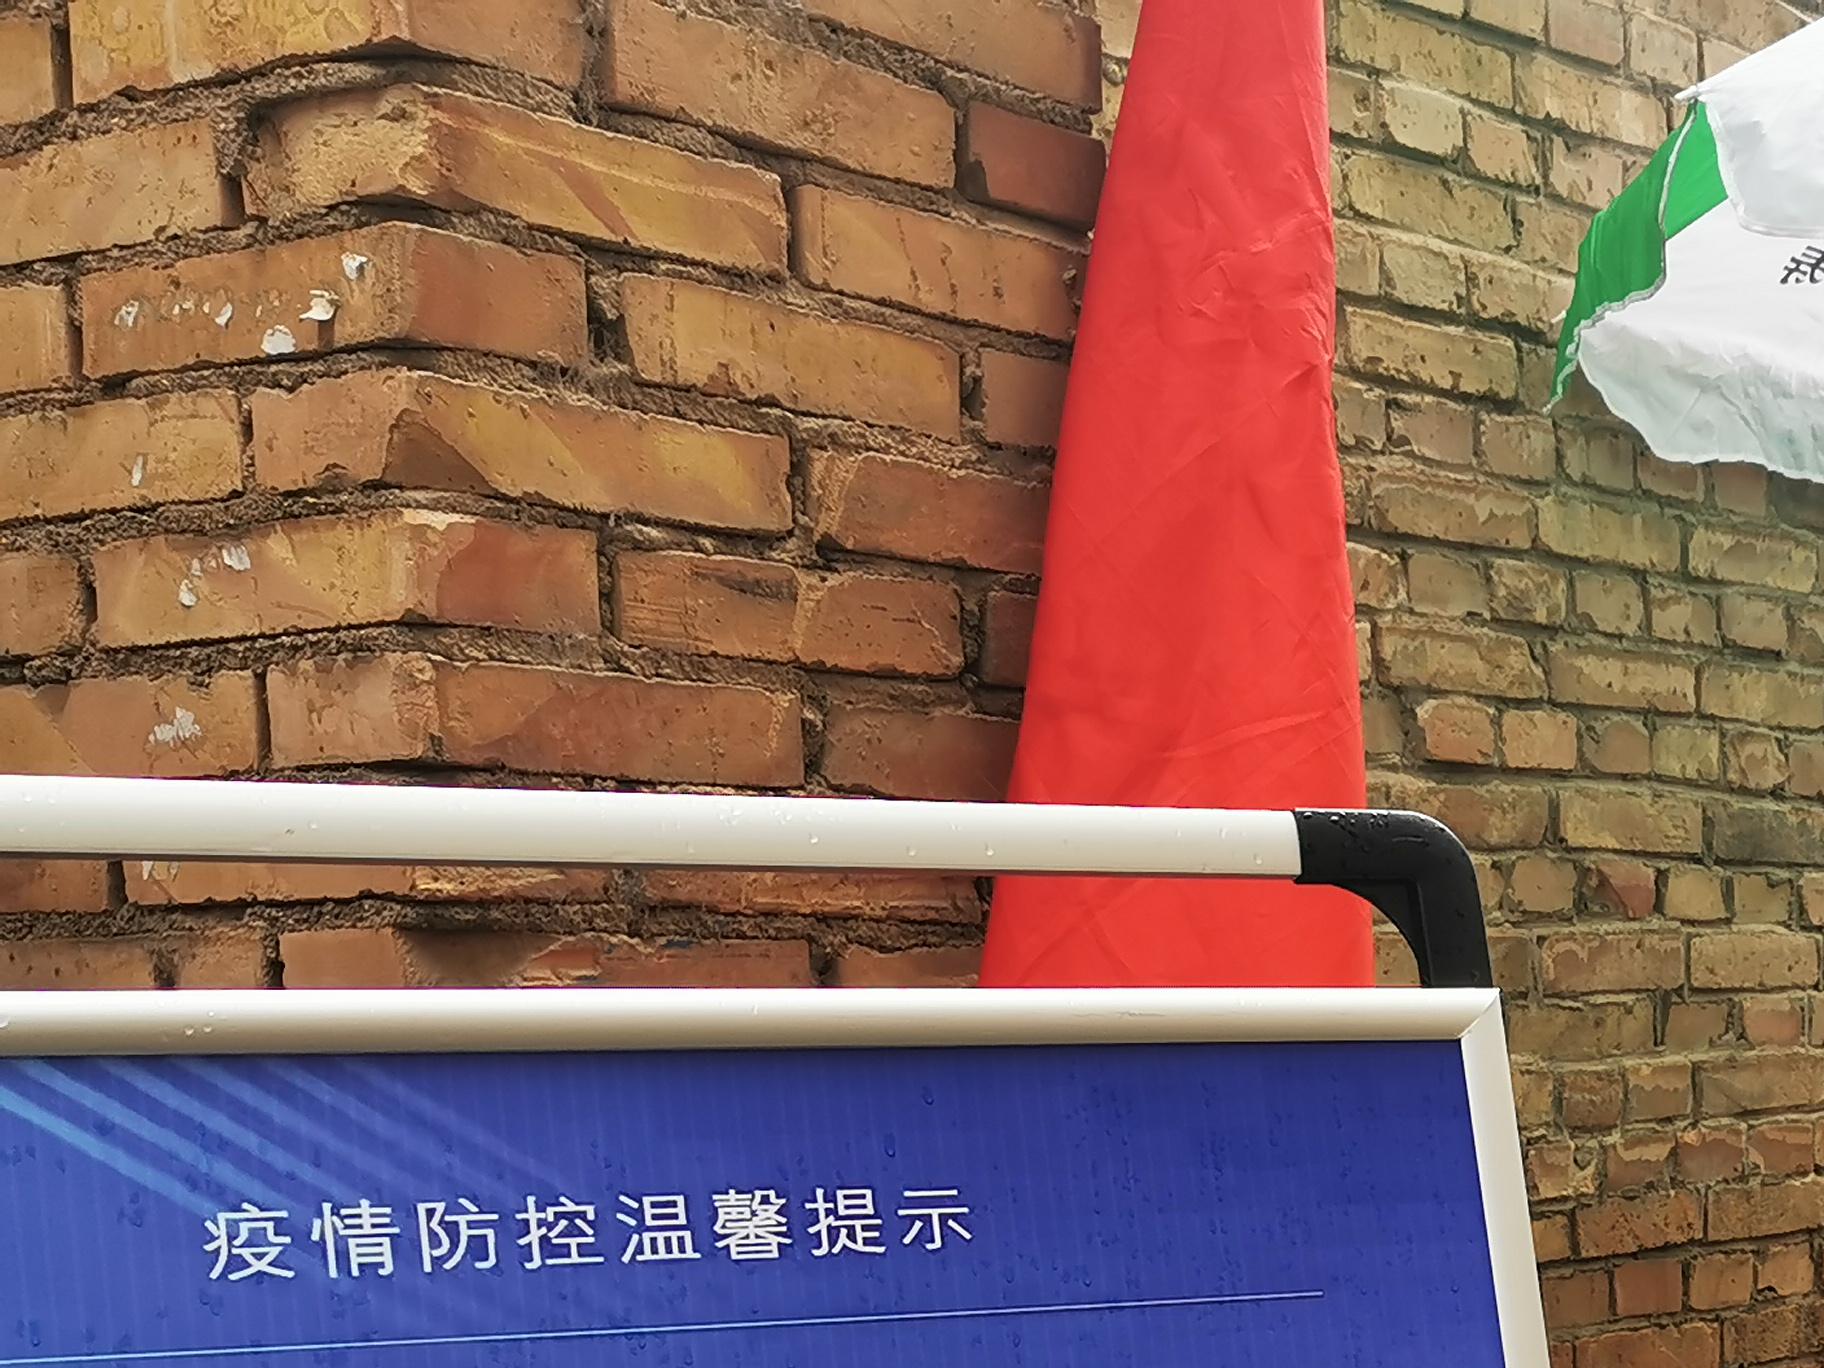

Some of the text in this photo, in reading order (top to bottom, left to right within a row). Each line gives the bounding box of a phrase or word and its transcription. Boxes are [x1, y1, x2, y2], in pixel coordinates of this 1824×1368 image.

[204, 1186, 975, 1283] 疫情防控温馨提示
